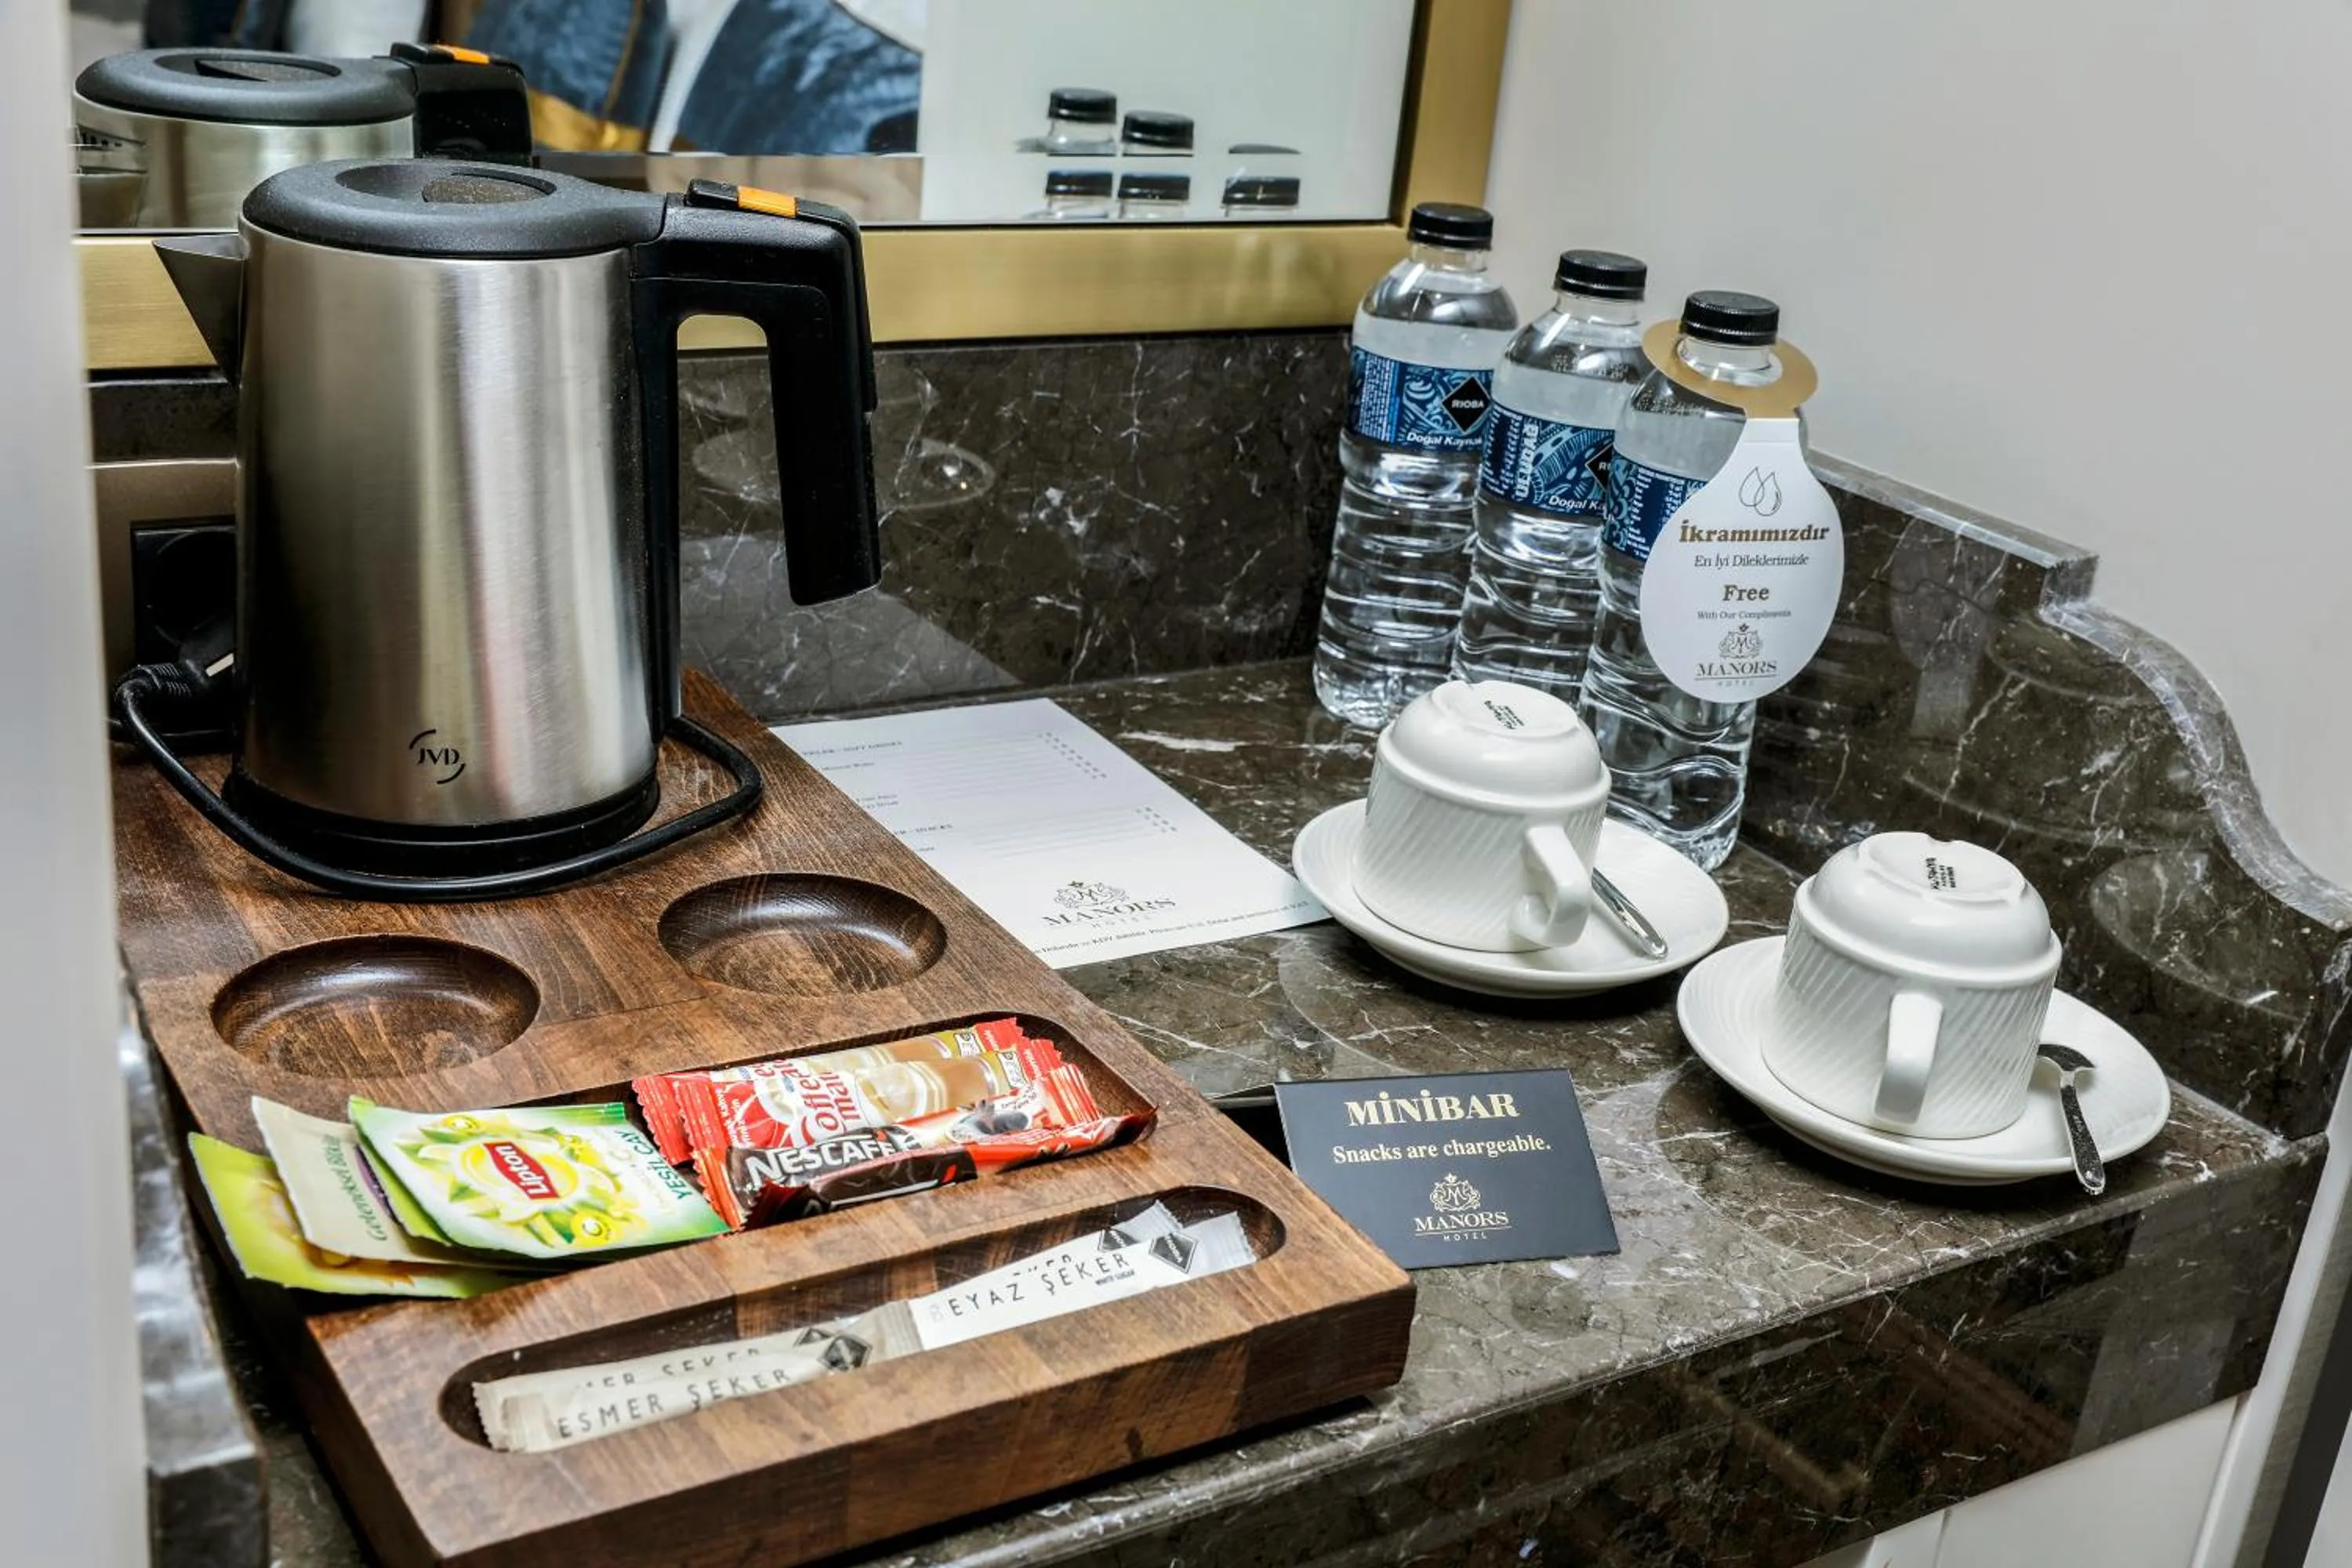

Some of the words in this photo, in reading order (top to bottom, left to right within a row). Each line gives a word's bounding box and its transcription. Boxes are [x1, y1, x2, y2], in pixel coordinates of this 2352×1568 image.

[1451, 399, 1485, 408] RIOBA
[1679, 520, 1830, 543] İkramımızdır
[1694, 555, 1712, 567] En
[1722, 584, 1769, 601] Free
[1697, 611, 1718, 620] With
[1719, 611, 1737, 620] Our
[1697, 660, 1778, 677] MANORS
[416, 748, 461, 766] JVD
[1041, 898, 1176, 927] MANORS
[1344, 1089, 1520, 1127] MİNİBAR
[1333, 1143, 1402, 1164] Snacks
[1406, 1145, 1438, 1159] are
[1443, 1134, 1552, 1158] chargeable.
[495, 1145, 550, 1194] Lipton
[1414, 1210, 1510, 1233] MANORS
[1443, 1232, 1489, 1242] HOTEL
[1041, 1253, 1130, 1295] ŞEKER
[558, 1393, 664, 1439] ESMER
[687, 1368, 790, 1411] ŞEKER
